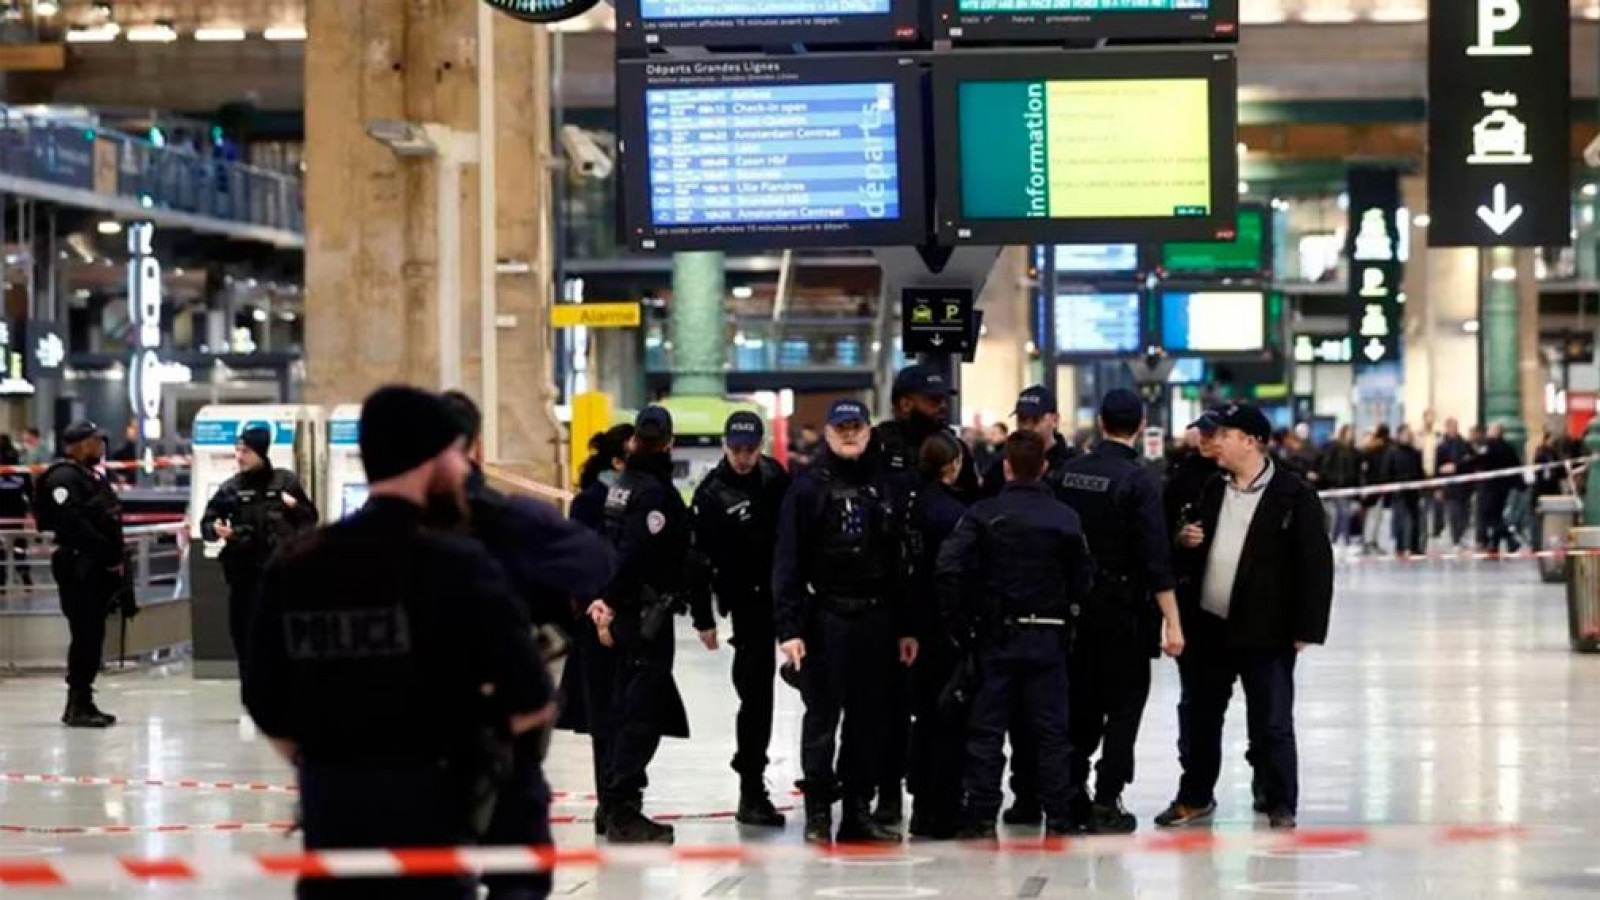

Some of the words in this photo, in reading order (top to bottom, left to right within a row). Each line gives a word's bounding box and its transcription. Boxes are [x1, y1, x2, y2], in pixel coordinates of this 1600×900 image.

[1478, 0, 1521, 46] P
[645, 63, 691, 77] Départs
[694, 62, 741, 74] Grandes
[743, 60, 780, 74] Lignes
[733, 102, 779, 114] Check-in
[781, 103, 808, 115] open
[735, 129, 795, 140] Amsterdam
[796, 127, 842, 139] Centraal
[1023, 83, 1046, 217] information
[859, 103, 892, 217] départs
[761, 181, 806, 193] Flandres
[737, 208, 798, 220] Amsterdam
[800, 206, 845, 219] Centraal
[580, 308, 637, 325] Alarme
[946, 304, 959, 320] P
[1065, 475, 1108, 491] POLICE
[287, 612, 405, 655] POLICE
